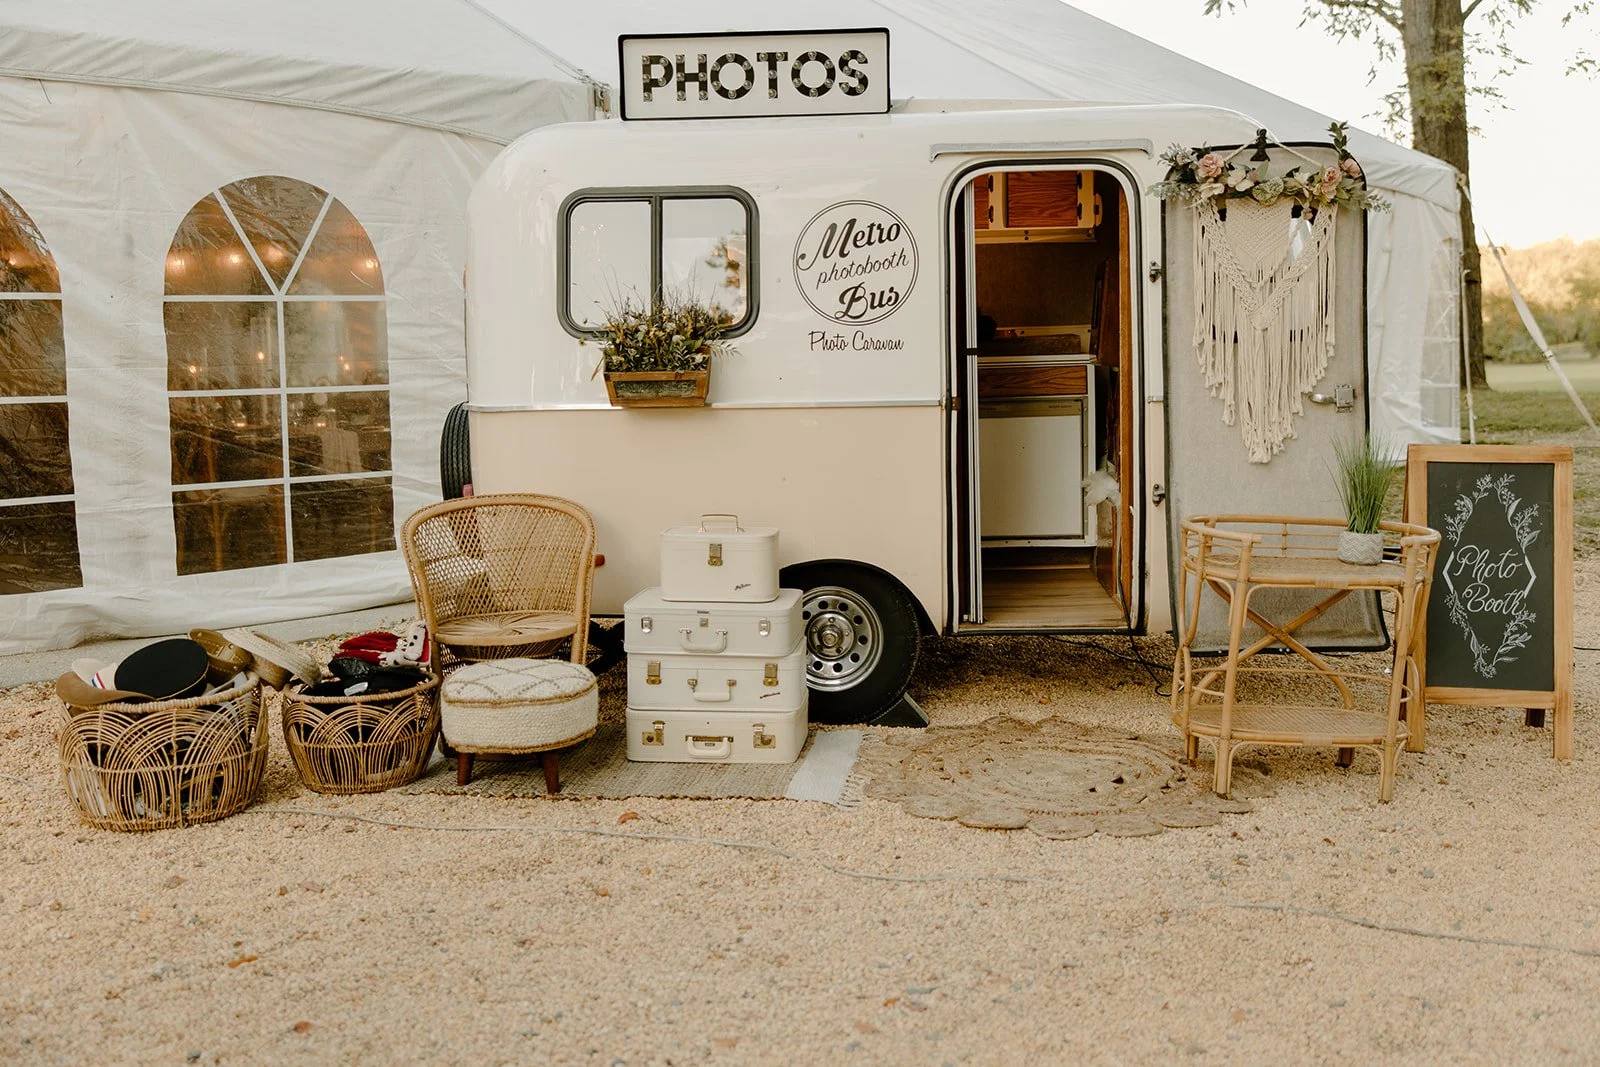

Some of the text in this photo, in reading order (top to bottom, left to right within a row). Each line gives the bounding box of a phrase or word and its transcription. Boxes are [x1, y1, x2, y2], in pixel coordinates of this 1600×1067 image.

[641, 50, 869, 102] PHOTOS
[796, 218, 901, 271] Metro
[816, 247, 909, 290] photobooth
[834, 281, 900, 320] Bus
[808, 330, 905, 351] Photo Caravan
[1453, 544, 1523, 584] Photo
[1462, 582, 1527, 616] Booth
